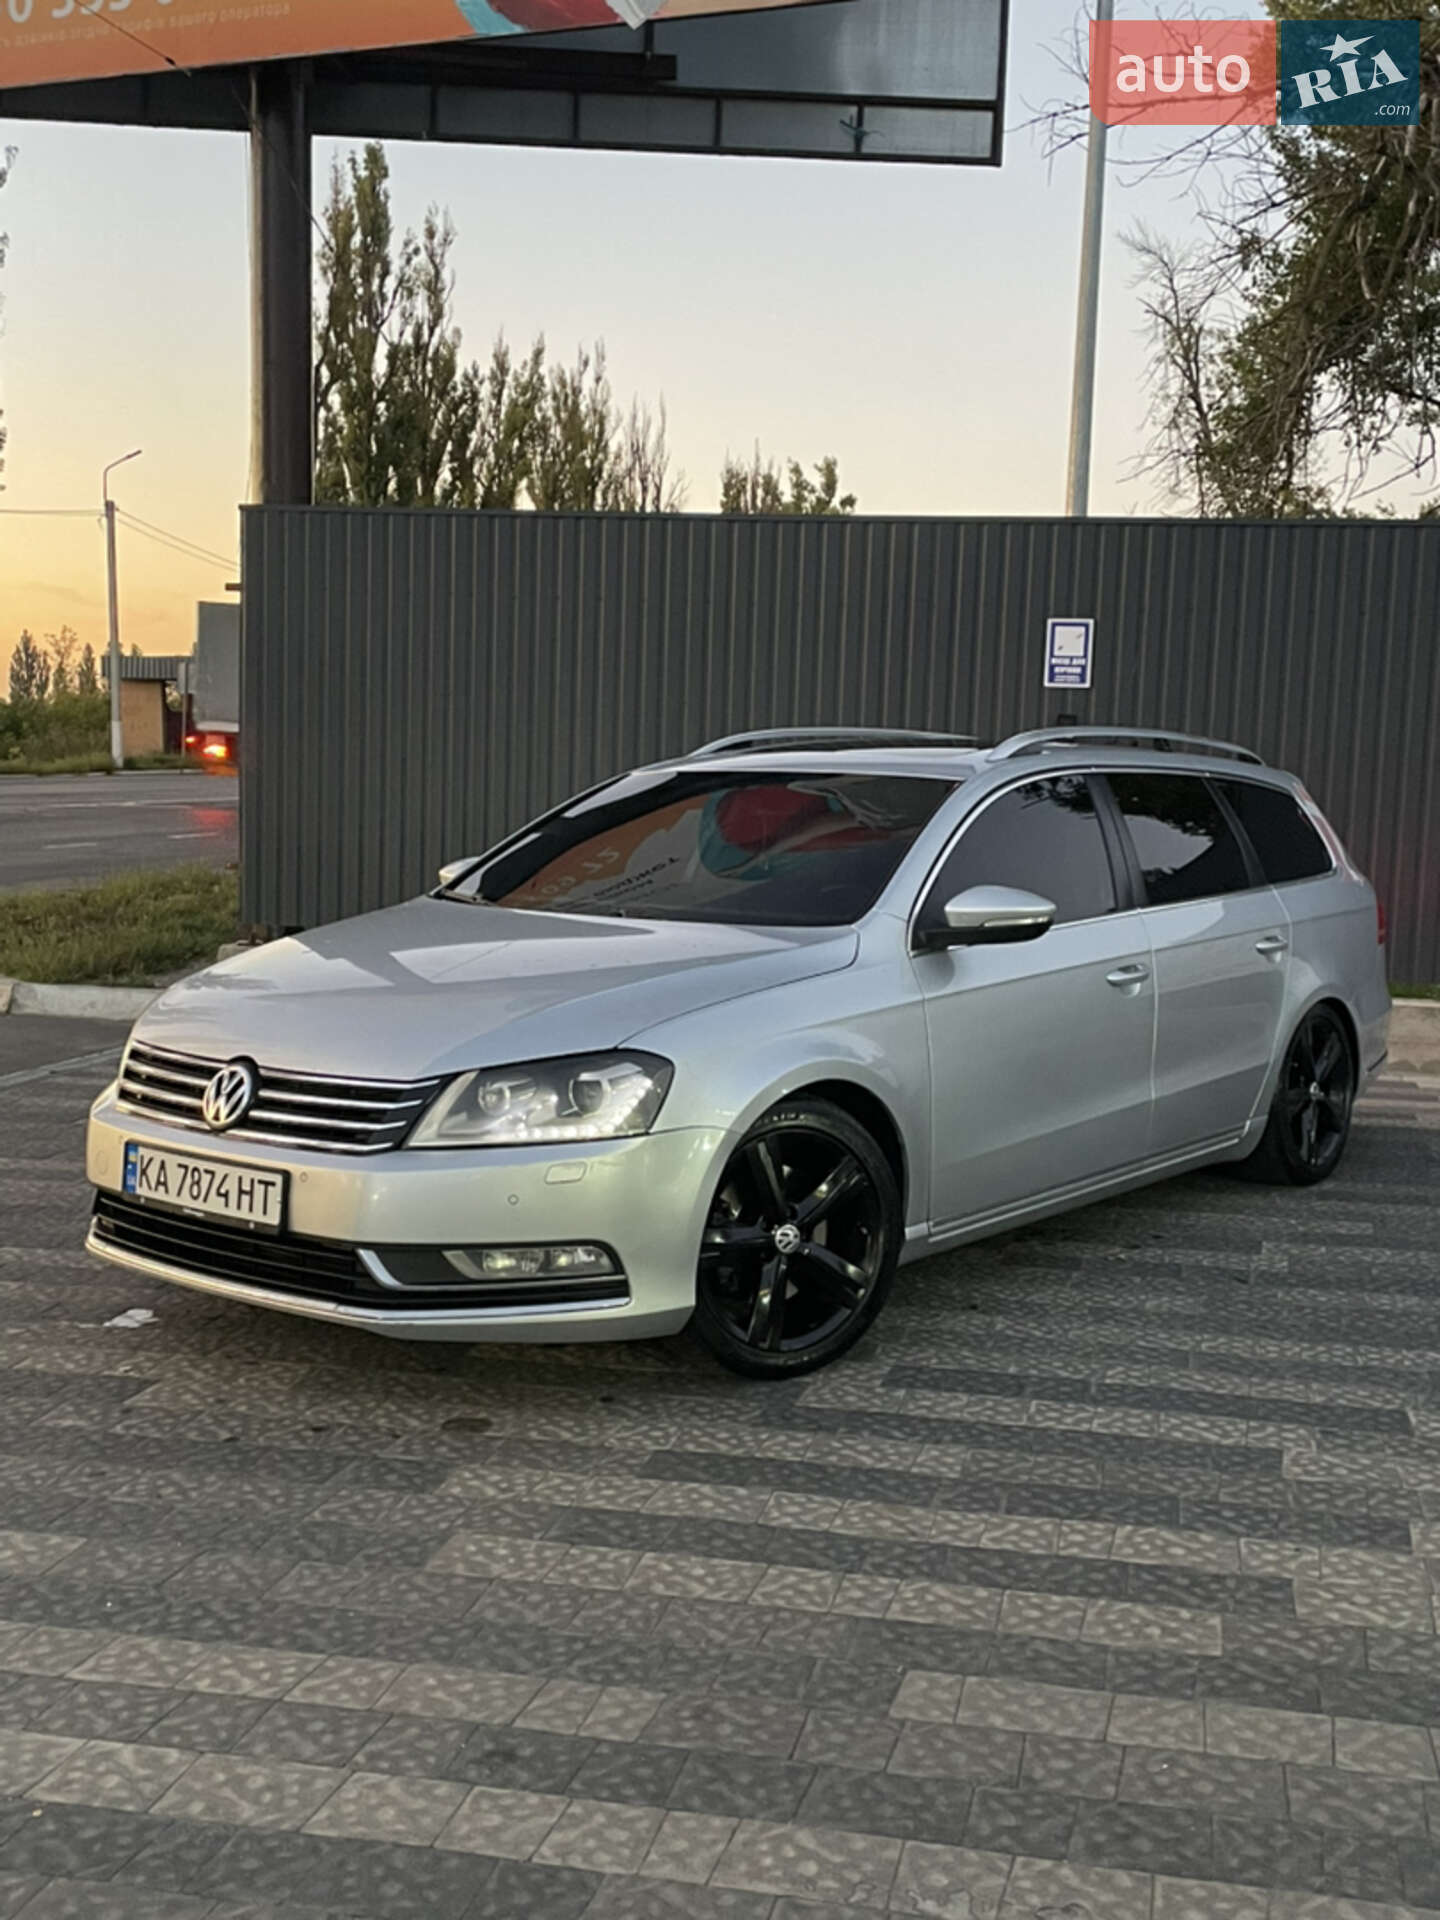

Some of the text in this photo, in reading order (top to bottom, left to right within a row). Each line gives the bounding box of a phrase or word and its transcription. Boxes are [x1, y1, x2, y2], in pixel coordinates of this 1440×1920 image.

[138, 1154, 277, 1217] KA 7874 HT
